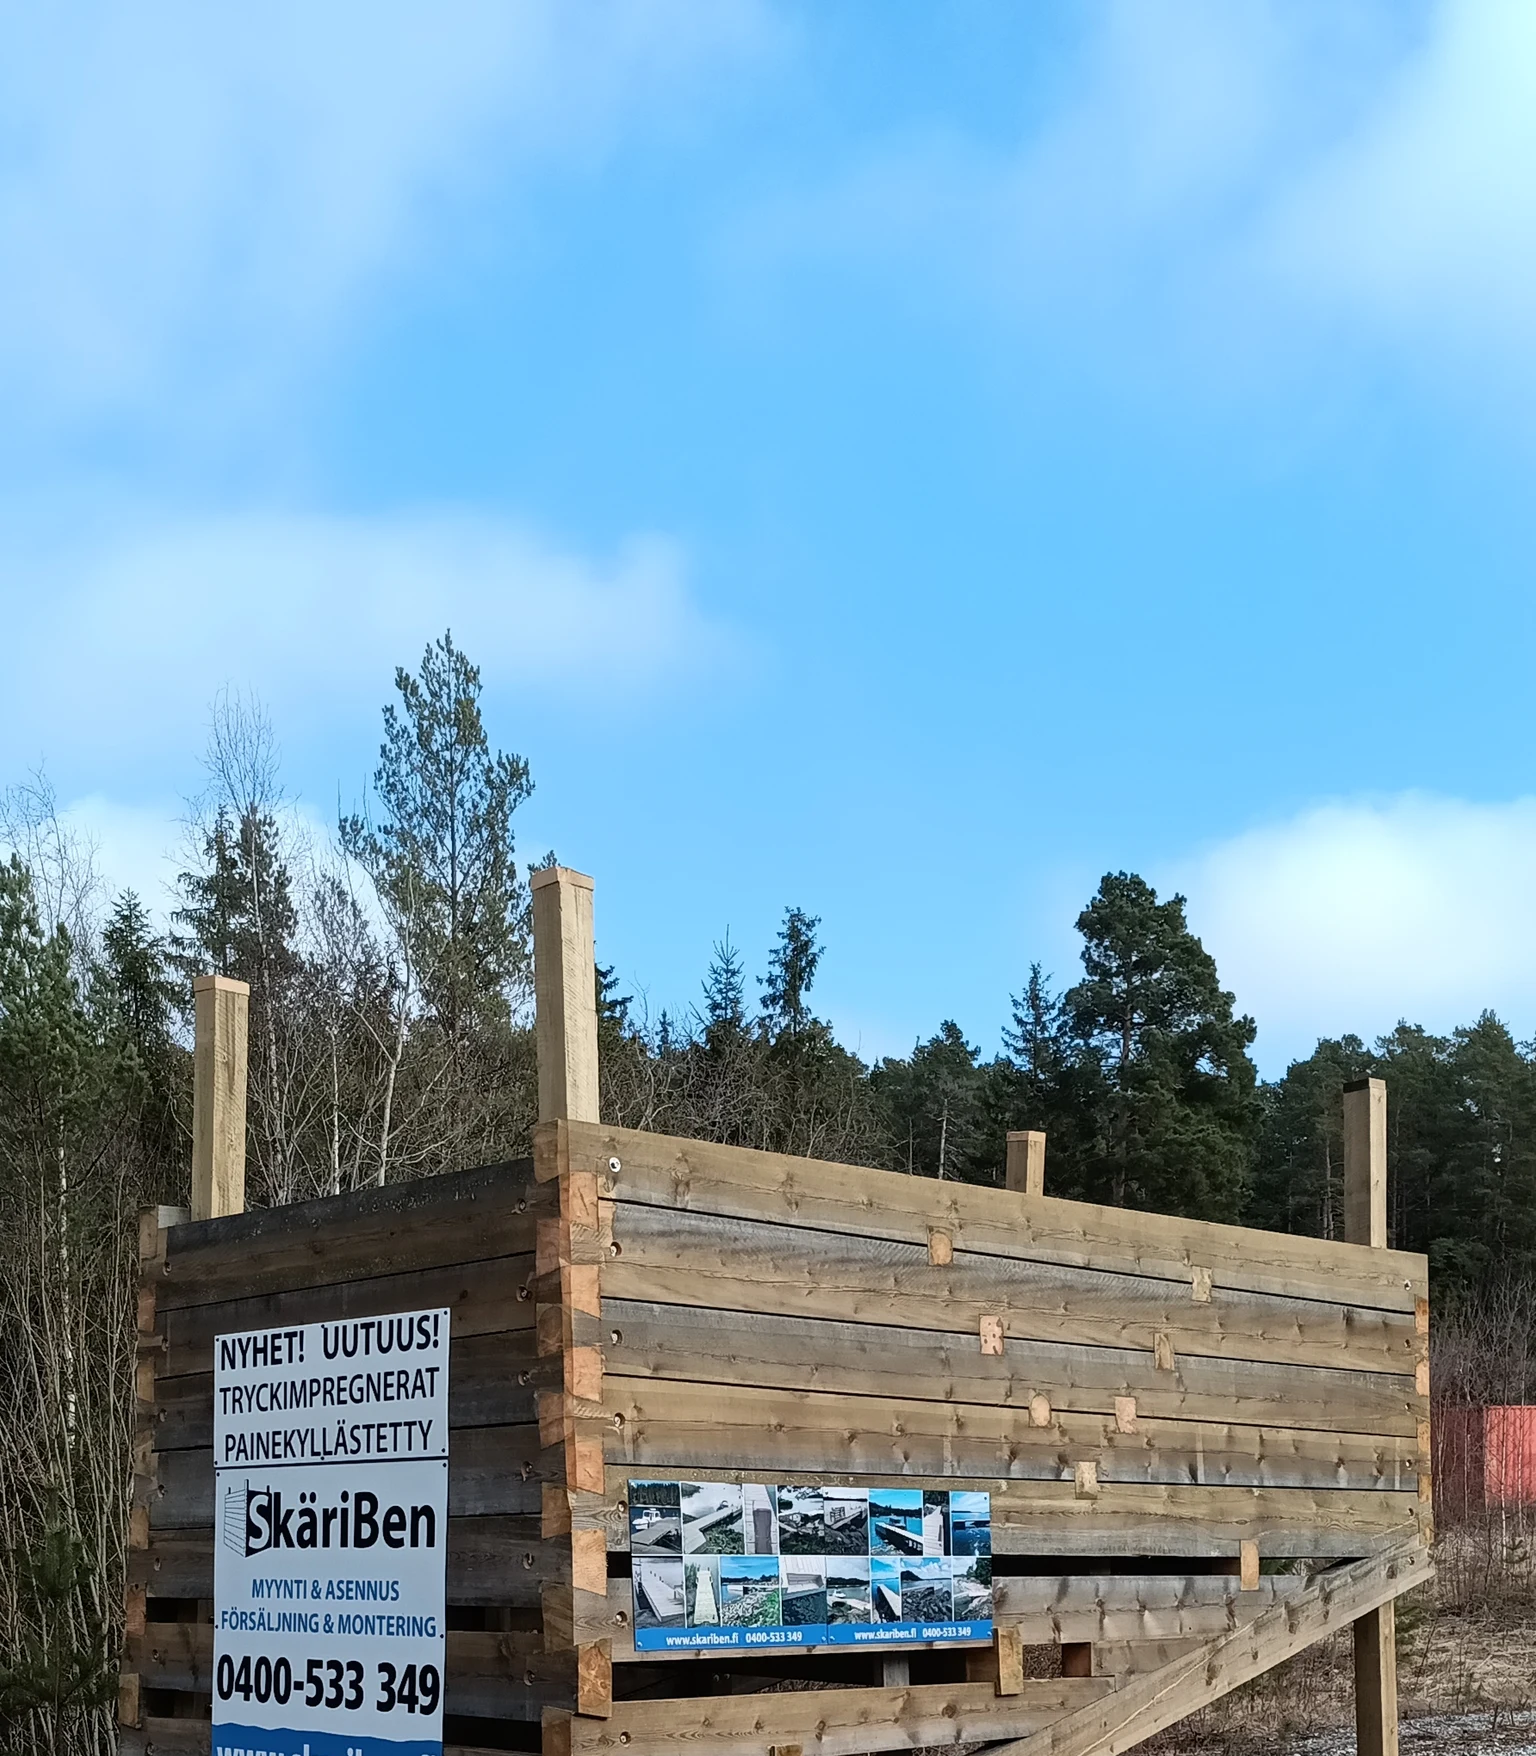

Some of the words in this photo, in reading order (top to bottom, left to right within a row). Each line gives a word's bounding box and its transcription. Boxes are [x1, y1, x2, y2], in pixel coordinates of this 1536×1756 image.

[220, 1329, 305, 1371] NYHET!
[322, 1313, 440, 1361] UUTUUS!
[219, 1366, 440, 1415] TRYCKIMPREGNERAT
[224, 1418, 433, 1462] PAINEKYLLÄSTETTY
[247, 1489, 436, 1549] SkäriBen
[251, 1578, 308, 1600] MYYNTI
[310, 1580, 322, 1600] &
[325, 1579, 400, 1602] ASENNUS
[221, 1606, 320, 1634] FÖRSÄLJNING
[323, 1612, 335, 1635] &
[337, 1614, 437, 1638] MONTERING
[665, 1632, 739, 1646] www.skariben.fi
[745, 1631, 786, 1644] 0400-533
[786, 1631, 803, 1643] 349
[854, 1627, 917, 1641] www.skariben.fi
[922, 1627, 957, 1639] 0400-533
[957, 1626, 972, 1638] 349
[216, 1653, 365, 1711] 0400-533
[376, 1661, 441, 1716] 349
